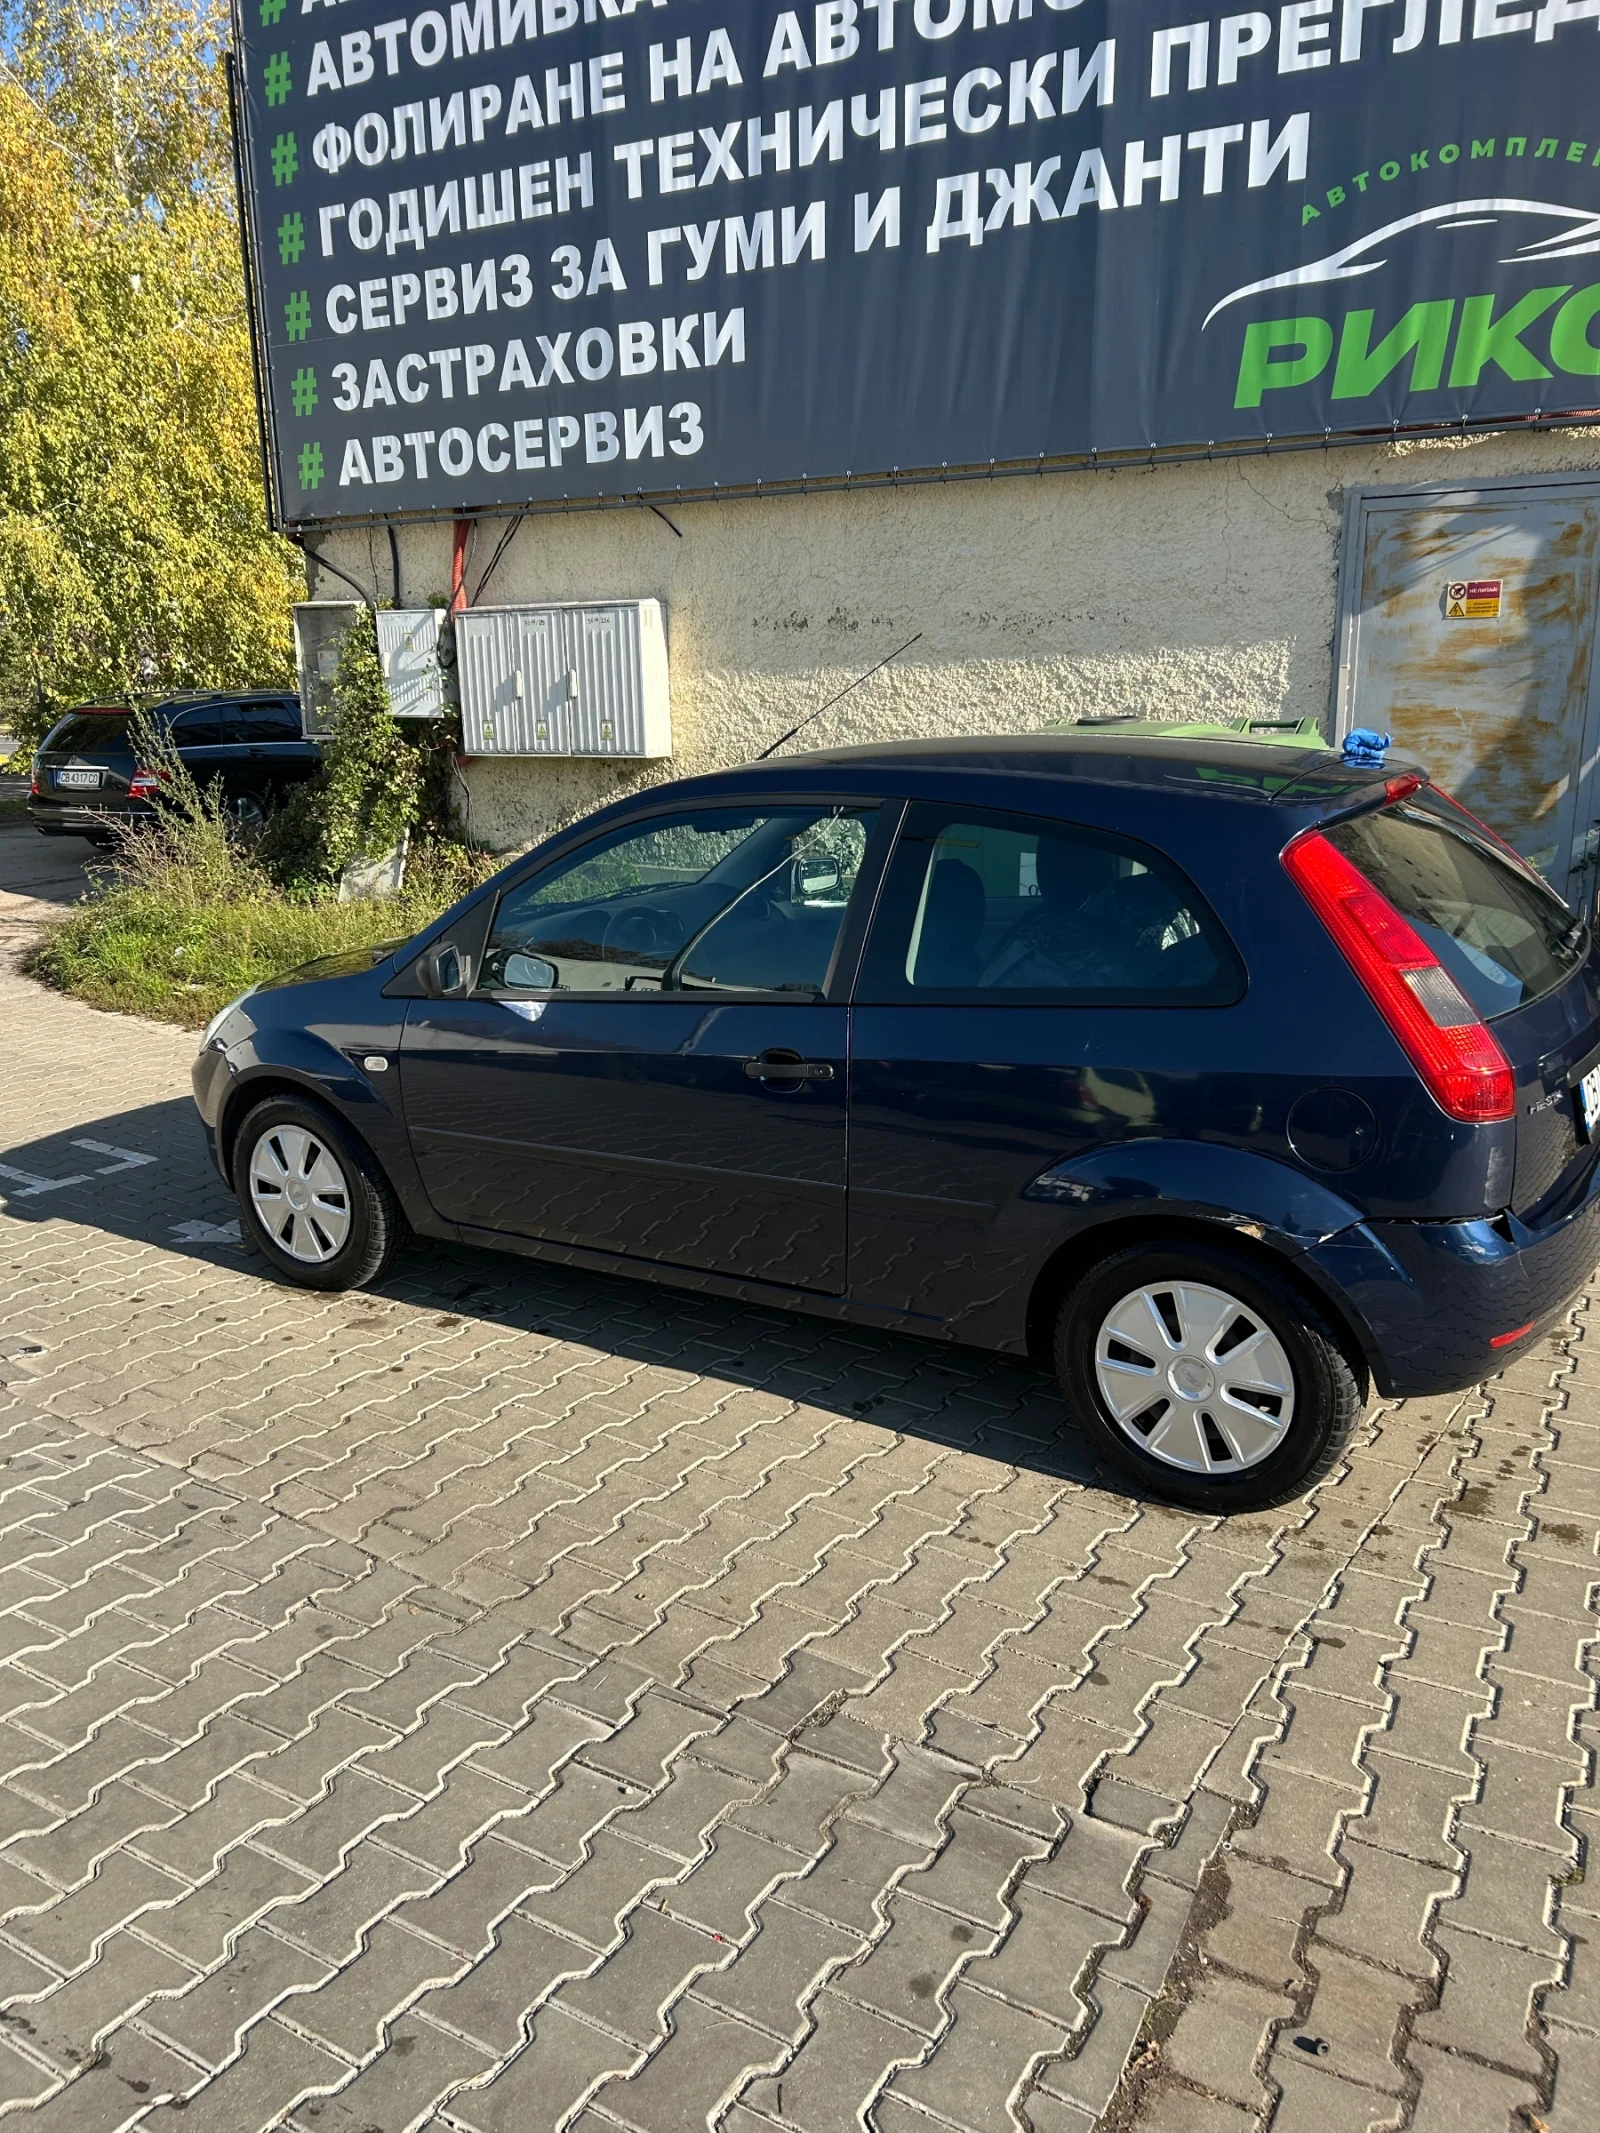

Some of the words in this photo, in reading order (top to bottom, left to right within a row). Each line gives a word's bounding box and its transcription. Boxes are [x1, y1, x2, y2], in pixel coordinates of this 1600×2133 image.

[306, 0, 667, 96] АВТОМИВ
[312, 51, 626, 174] ФОЛИРАНЕ
[648, 27, 744, 103] НА
[762, 0, 1085, 78] АВТО
[318, 152, 594, 257] ГОДИШЕН
[613, 38, 1116, 200] ТЕХНИЧЕСКИ
[325, 253, 533, 335] СЕРВИЗ
[550, 237, 627, 300] ЗА
[647, 200, 826, 286] ГУМИ
[854, 186, 901, 253] И
[926, 111, 1311, 254] ДЖАНТИ
[331, 307, 746, 412] ЗАСТРАХОВКИ
[338, 401, 704, 486] АВТОСЕРВИЗ
[71, 772, 87, 783] 4317
